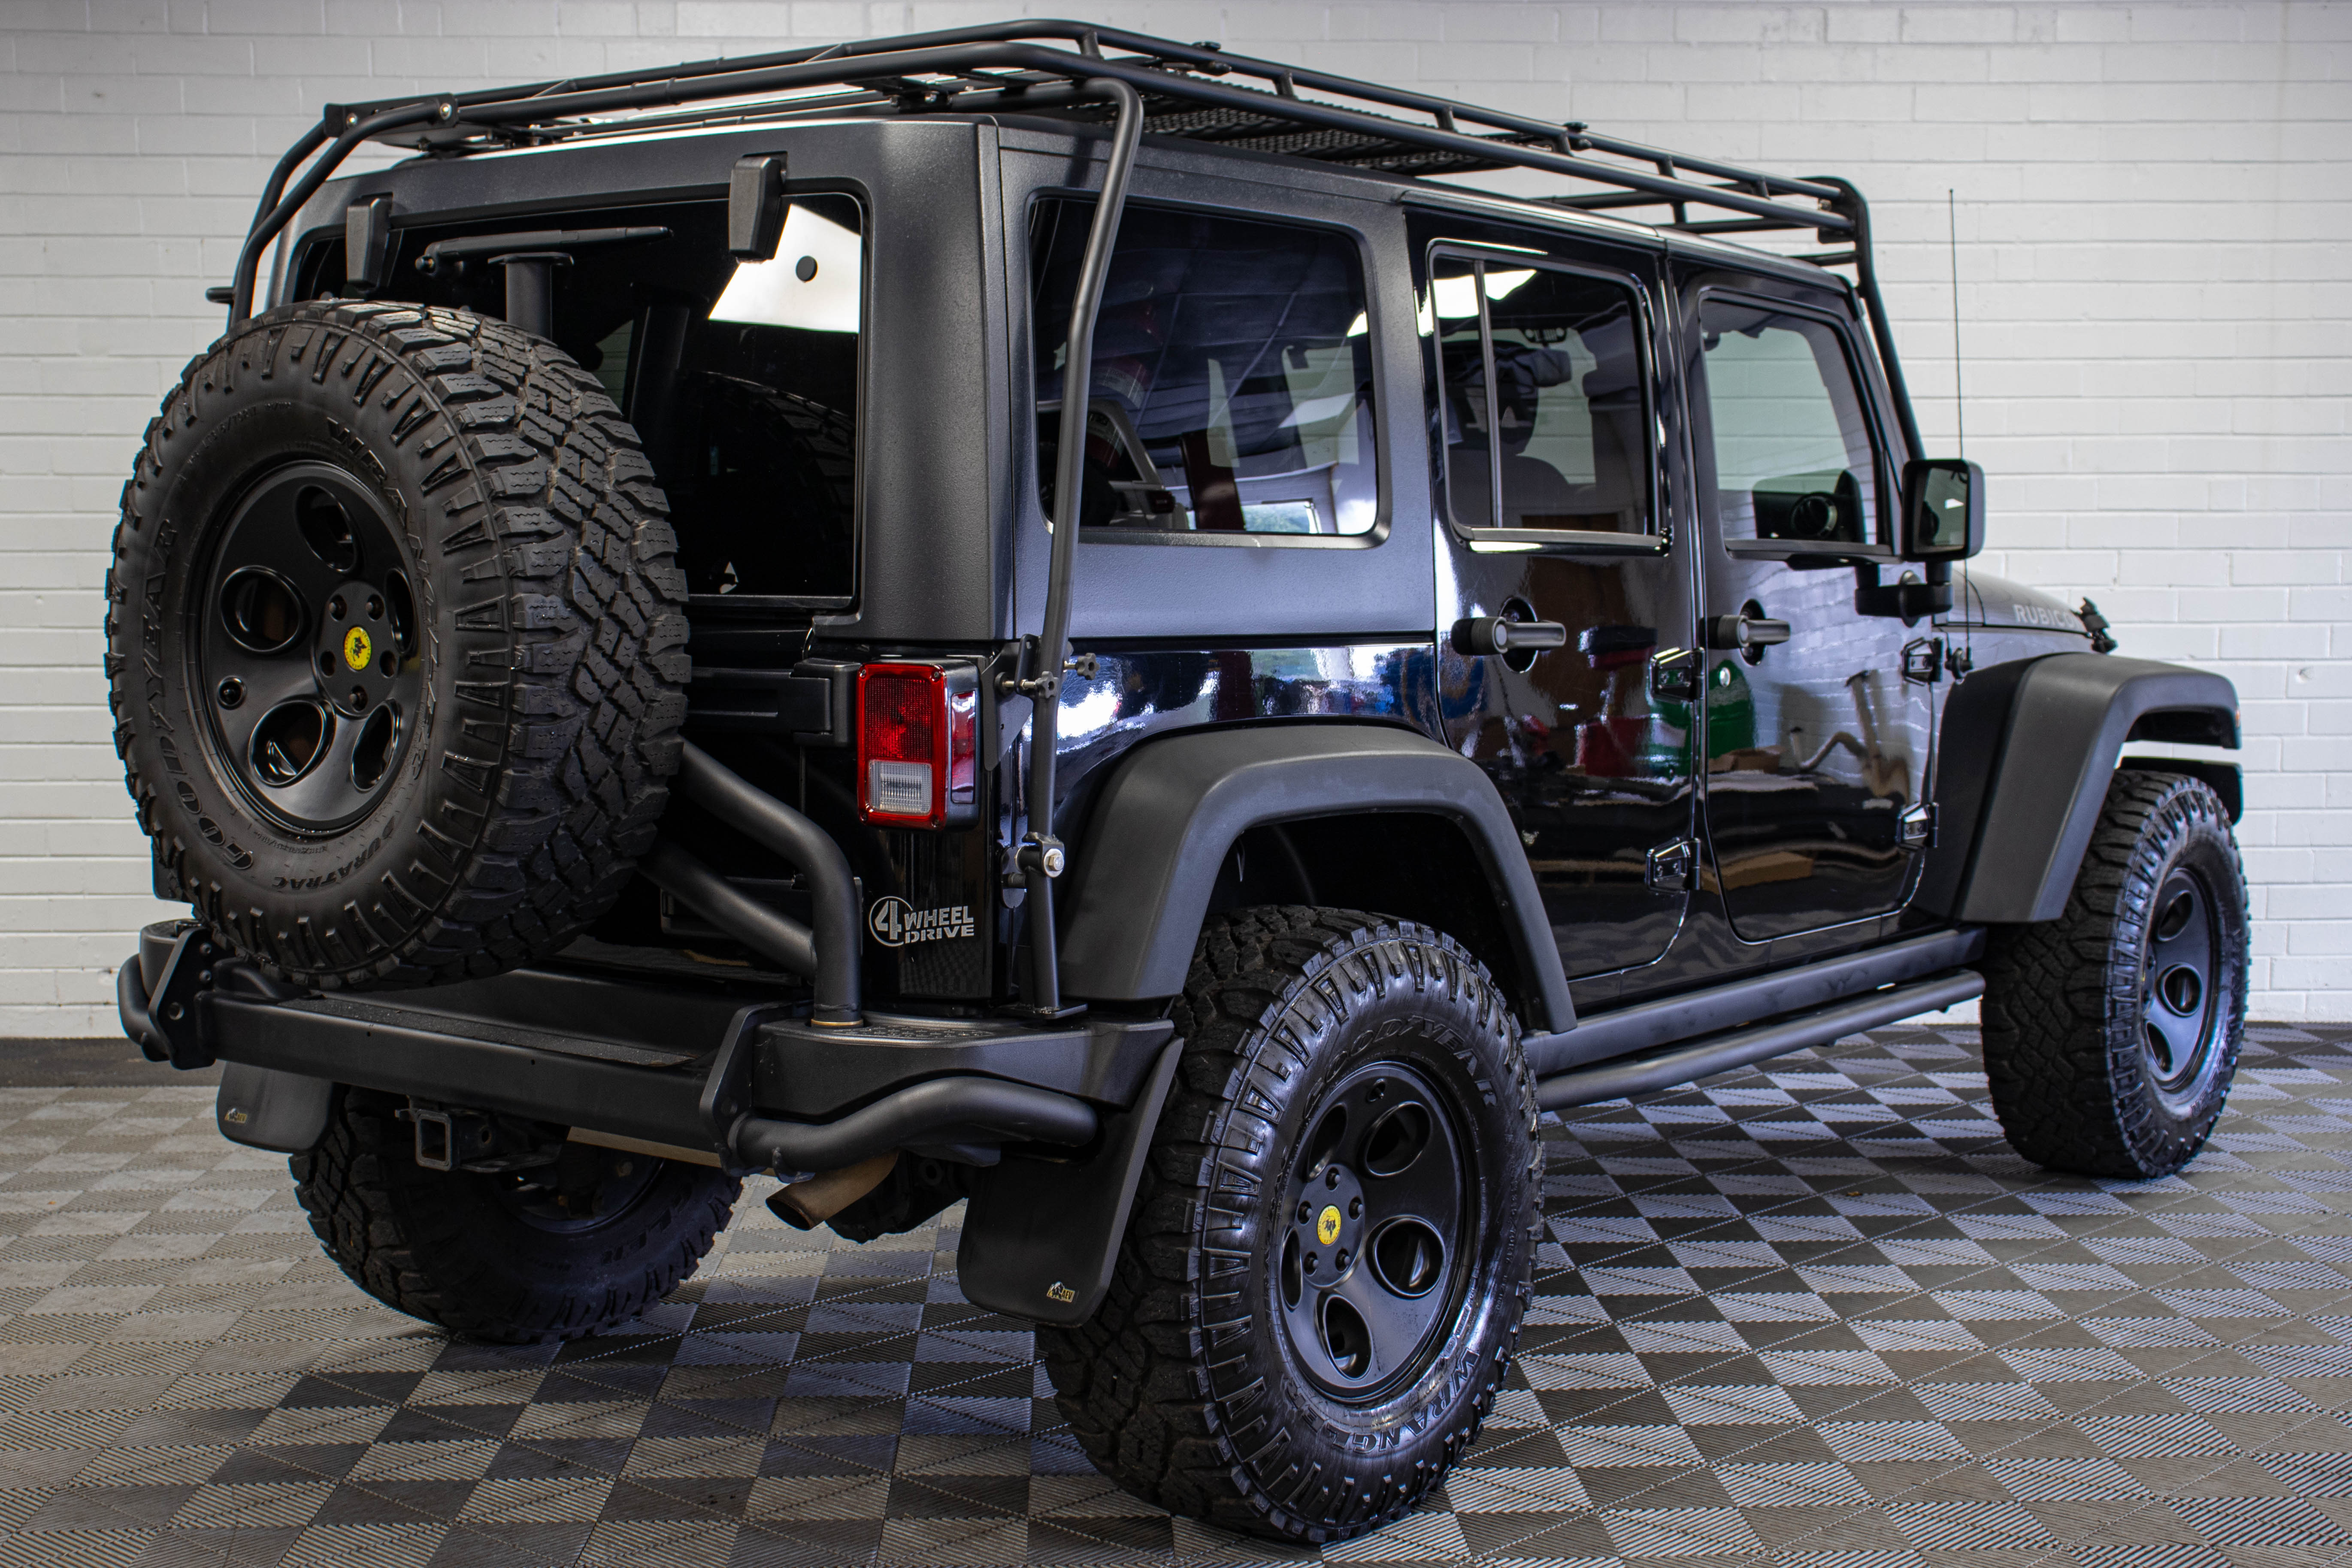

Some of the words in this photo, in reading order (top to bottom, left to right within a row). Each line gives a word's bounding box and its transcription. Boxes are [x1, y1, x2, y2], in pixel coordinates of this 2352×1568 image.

[326, 416, 439, 779] WRANGLER
[142, 518, 254, 870] GOODYEAR
[272, 815, 394, 890] DURATRAC
[875, 900, 902, 940] 4
[904, 905, 974, 930] WHEEL
[905, 924, 975, 944] DRIVE
[1304, 1015, 1498, 1119] GOODYEAR
[1062, 1289, 1073, 1300] AEV
[1284, 1347, 1480, 1455] WRANGLER
